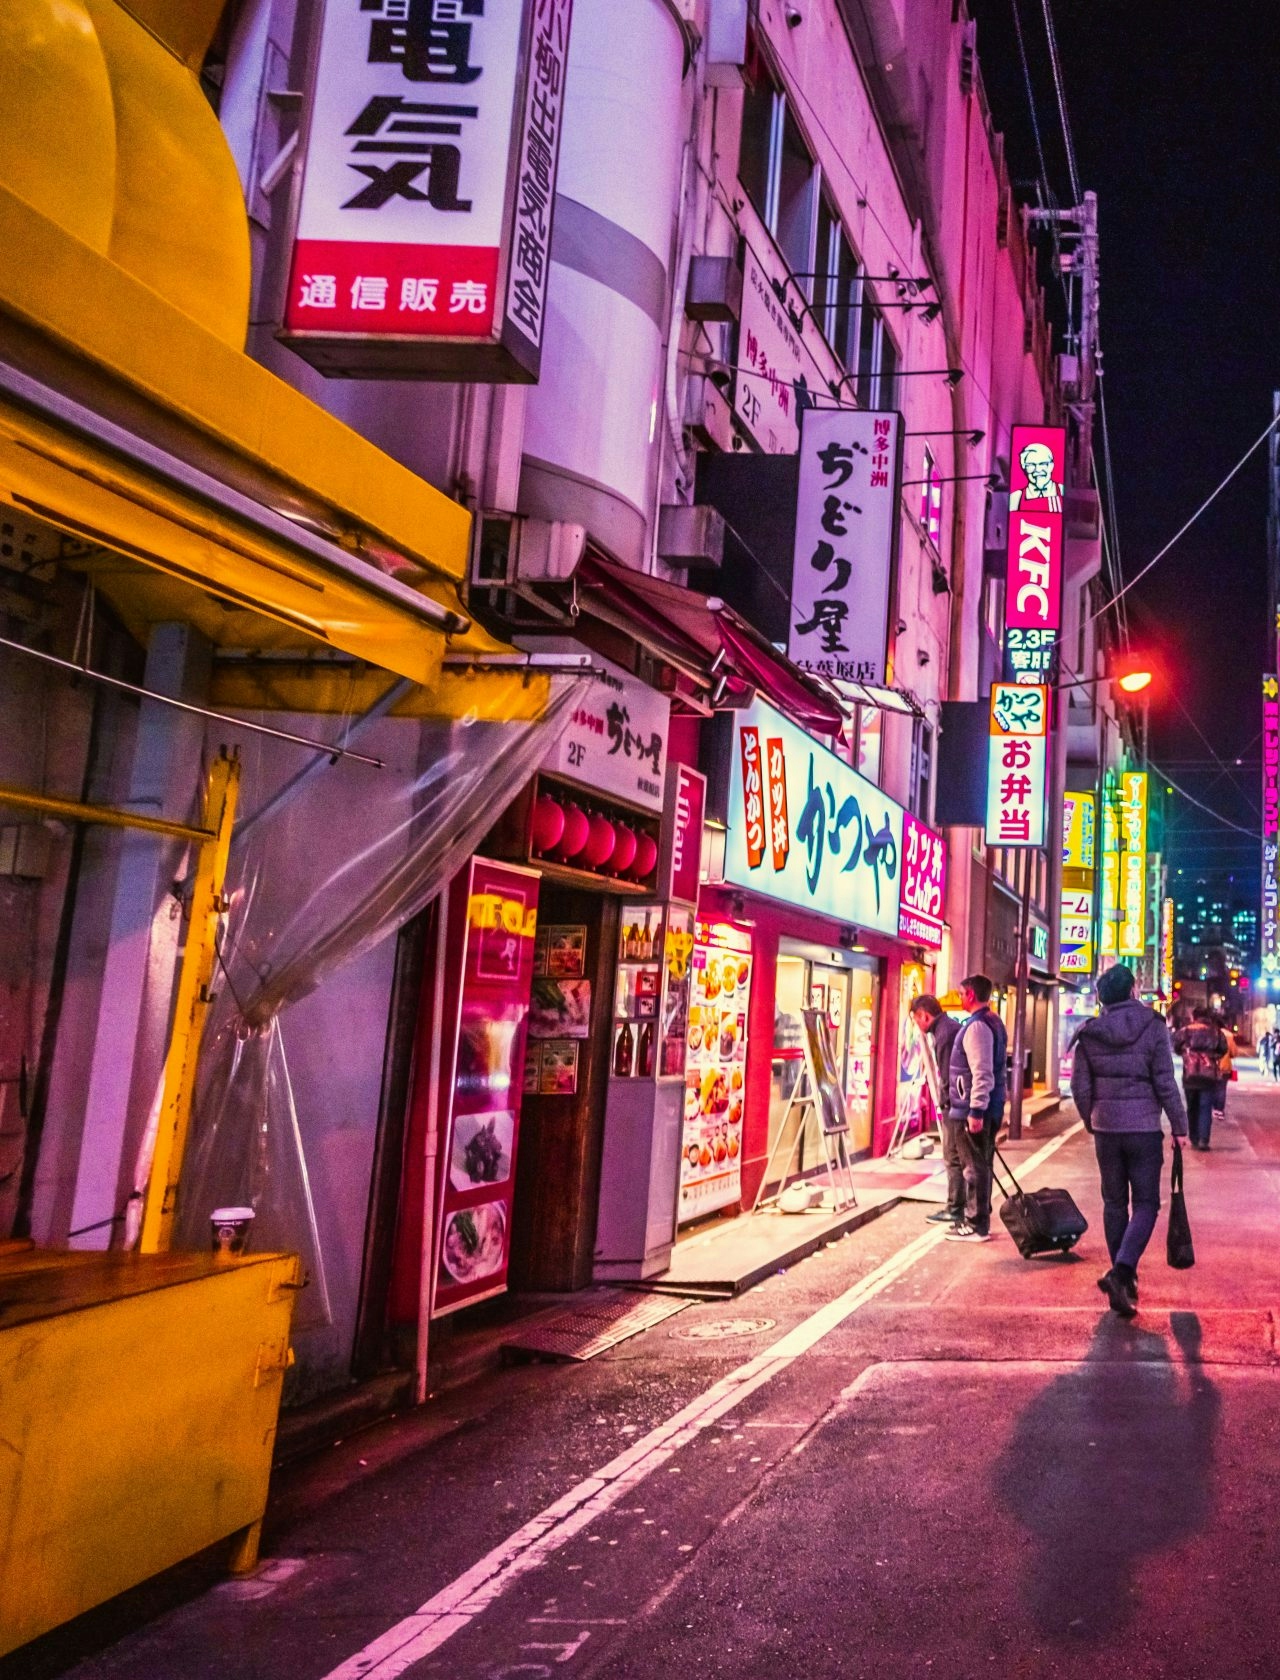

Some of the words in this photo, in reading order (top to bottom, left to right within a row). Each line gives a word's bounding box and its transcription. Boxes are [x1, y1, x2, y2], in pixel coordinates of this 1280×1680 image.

[298, 274, 488, 314] 通信販売
[742, 384, 762, 428] 2F
[870, 418, 891, 488] 博多中洲
[794, 441, 869, 653] ぢどり屋
[1015, 518, 1052, 620] KFC
[567, 740, 587, 767] 2F
[743, 732, 763, 850] とんかつ
[998, 739, 1032, 841] お弁当
[770, 746, 788, 854] カツ丼
[796, 752, 898, 918] かつや
[904, 865, 942, 916] とんかつ
[906, 820, 943, 884] カツ丼
